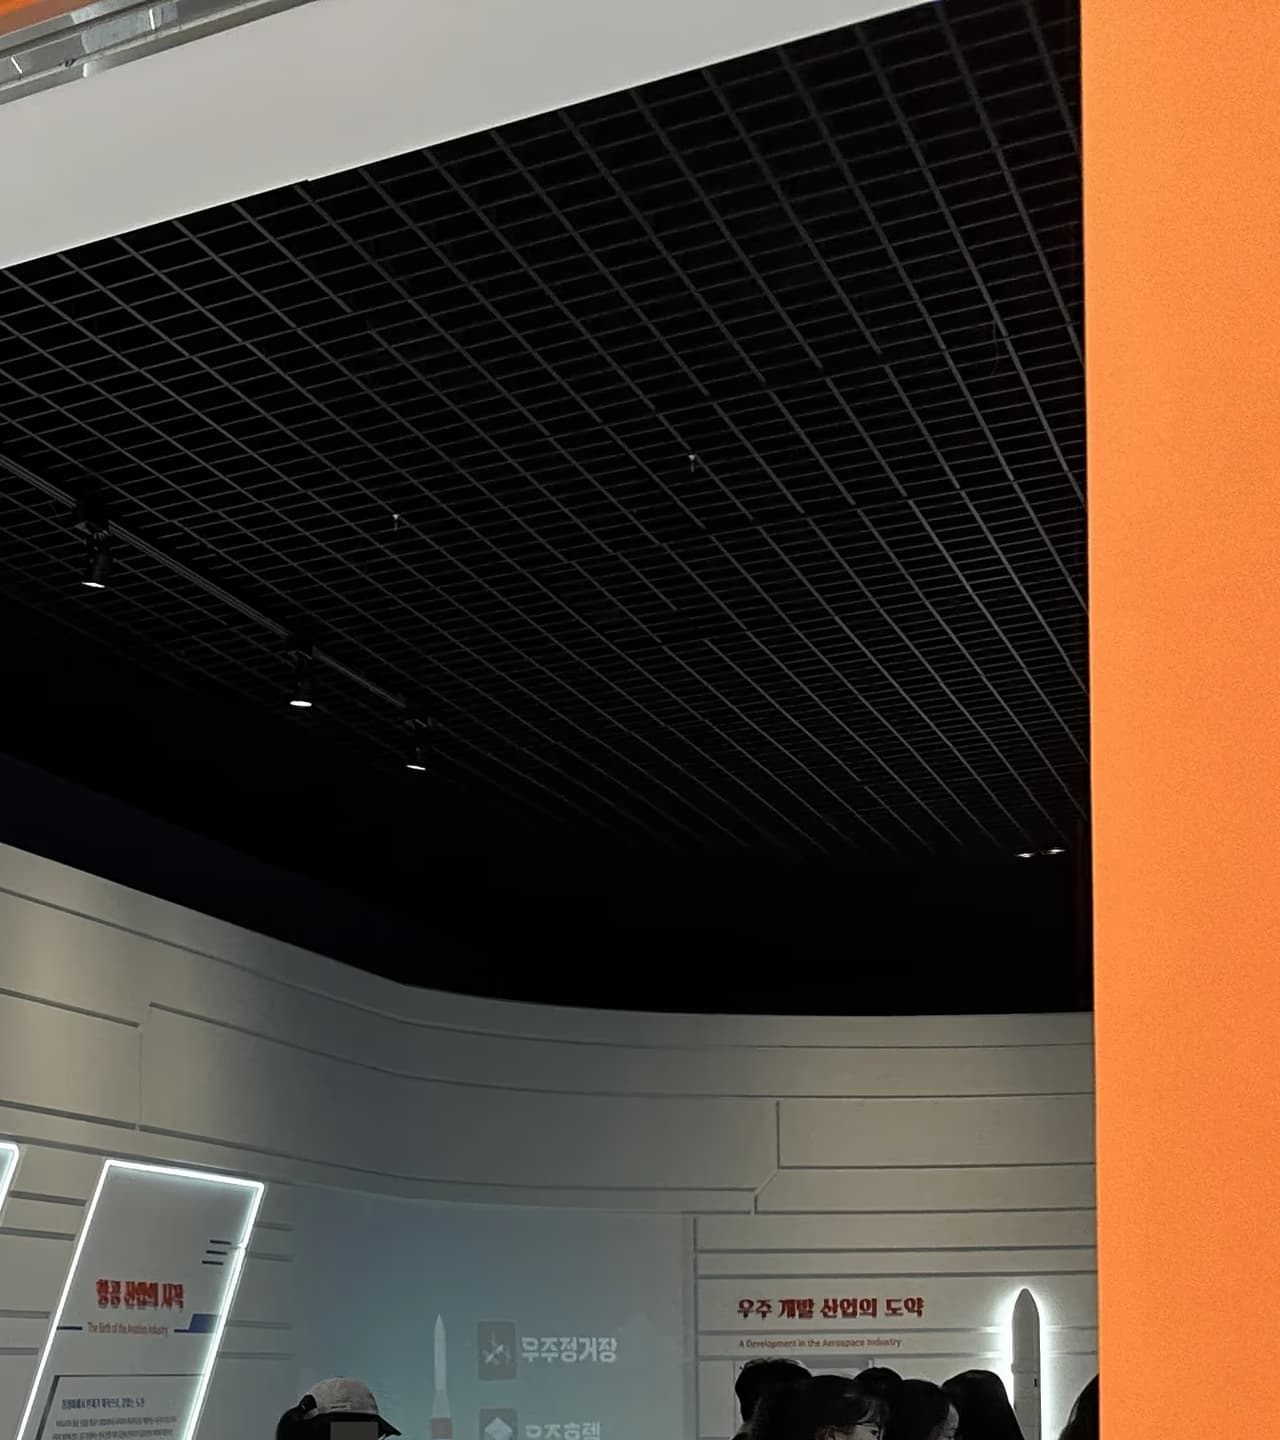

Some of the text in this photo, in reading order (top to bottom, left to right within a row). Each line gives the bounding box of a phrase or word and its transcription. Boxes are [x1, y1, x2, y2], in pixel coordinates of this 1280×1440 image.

[96, 1279, 184, 1308] 항공 산업의 시작
[737, 1297, 925, 1320] 우주 개발 산업의 도약
[521, 1337, 617, 1362] 우주정거장
[739, 1337, 903, 1350] A Development in the Aerospace Industry
